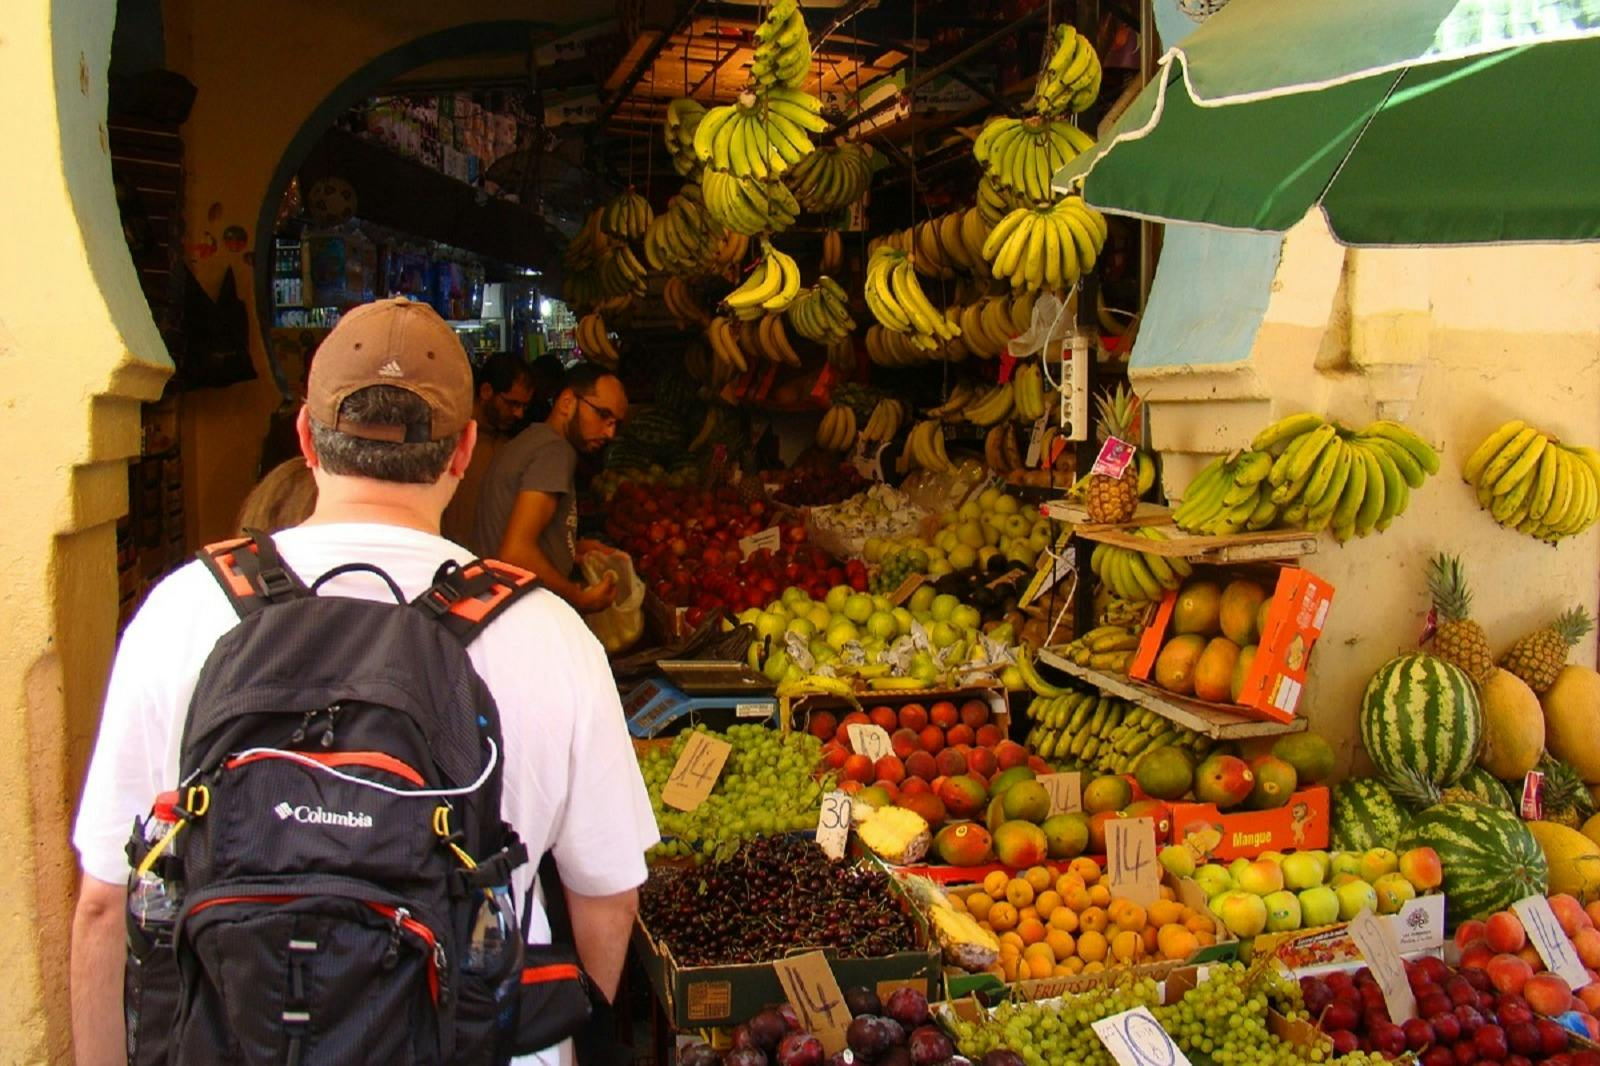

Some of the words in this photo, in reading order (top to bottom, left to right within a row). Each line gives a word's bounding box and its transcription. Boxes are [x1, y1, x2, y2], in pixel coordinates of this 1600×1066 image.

[671, 737, 716, 789] 14
[294, 805, 373, 828] Columbia
[822, 797, 852, 829] 30
[1111, 825, 1153, 886] 14
[1232, 831, 1272, 848] Mangue
[1528, 904, 1568, 972] 14
[784, 965, 840, 1034] 14
[1033, 980, 1081, 1000] FRUITS
